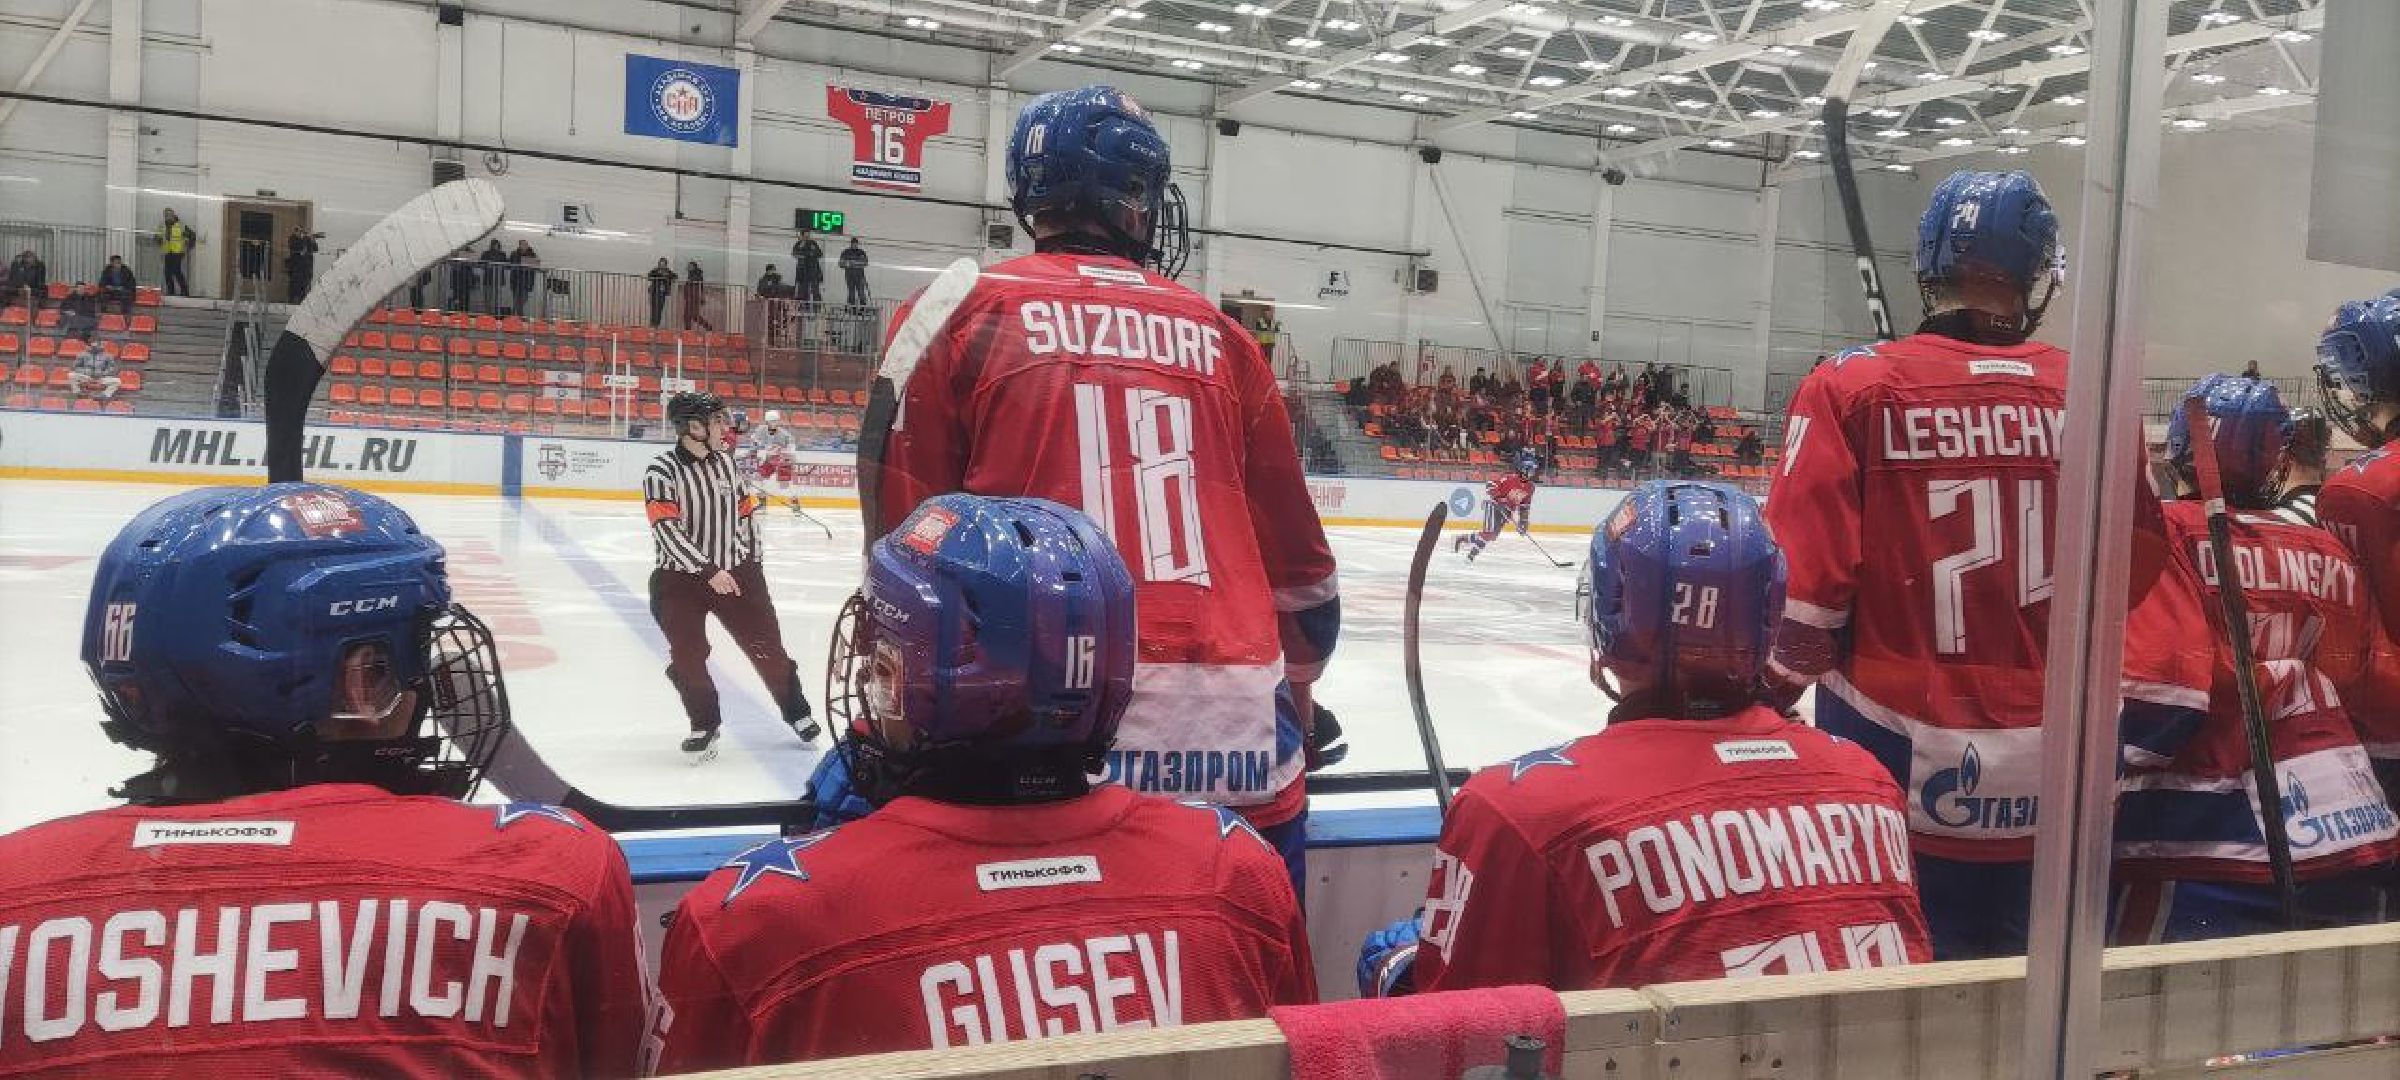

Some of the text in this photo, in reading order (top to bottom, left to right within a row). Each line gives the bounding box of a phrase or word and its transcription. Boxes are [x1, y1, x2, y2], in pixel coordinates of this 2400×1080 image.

[865, 107, 916, 123] ПЕТРОВ
[871, 124, 905, 164] 16
[1020, 301, 1221, 376] SUZDORF
[150, 428, 416, 472] MHL.HL.RU
[1074, 384, 1212, 587] 18
[330, 596, 398, 616] CCM
[875, 598, 910, 622] CCM
[1672, 582, 1719, 628] 28
[105, 604, 136, 661] 66
[1065, 636, 1096, 688] 16
[1124, 750, 1270, 792] ГАЗПРОМ
[150, 827, 278, 839] ТИНЬКОФФ
[989, 865, 1088, 882] ТИНЬКОФФ
[920, 930, 1182, 1050] GUSEV
